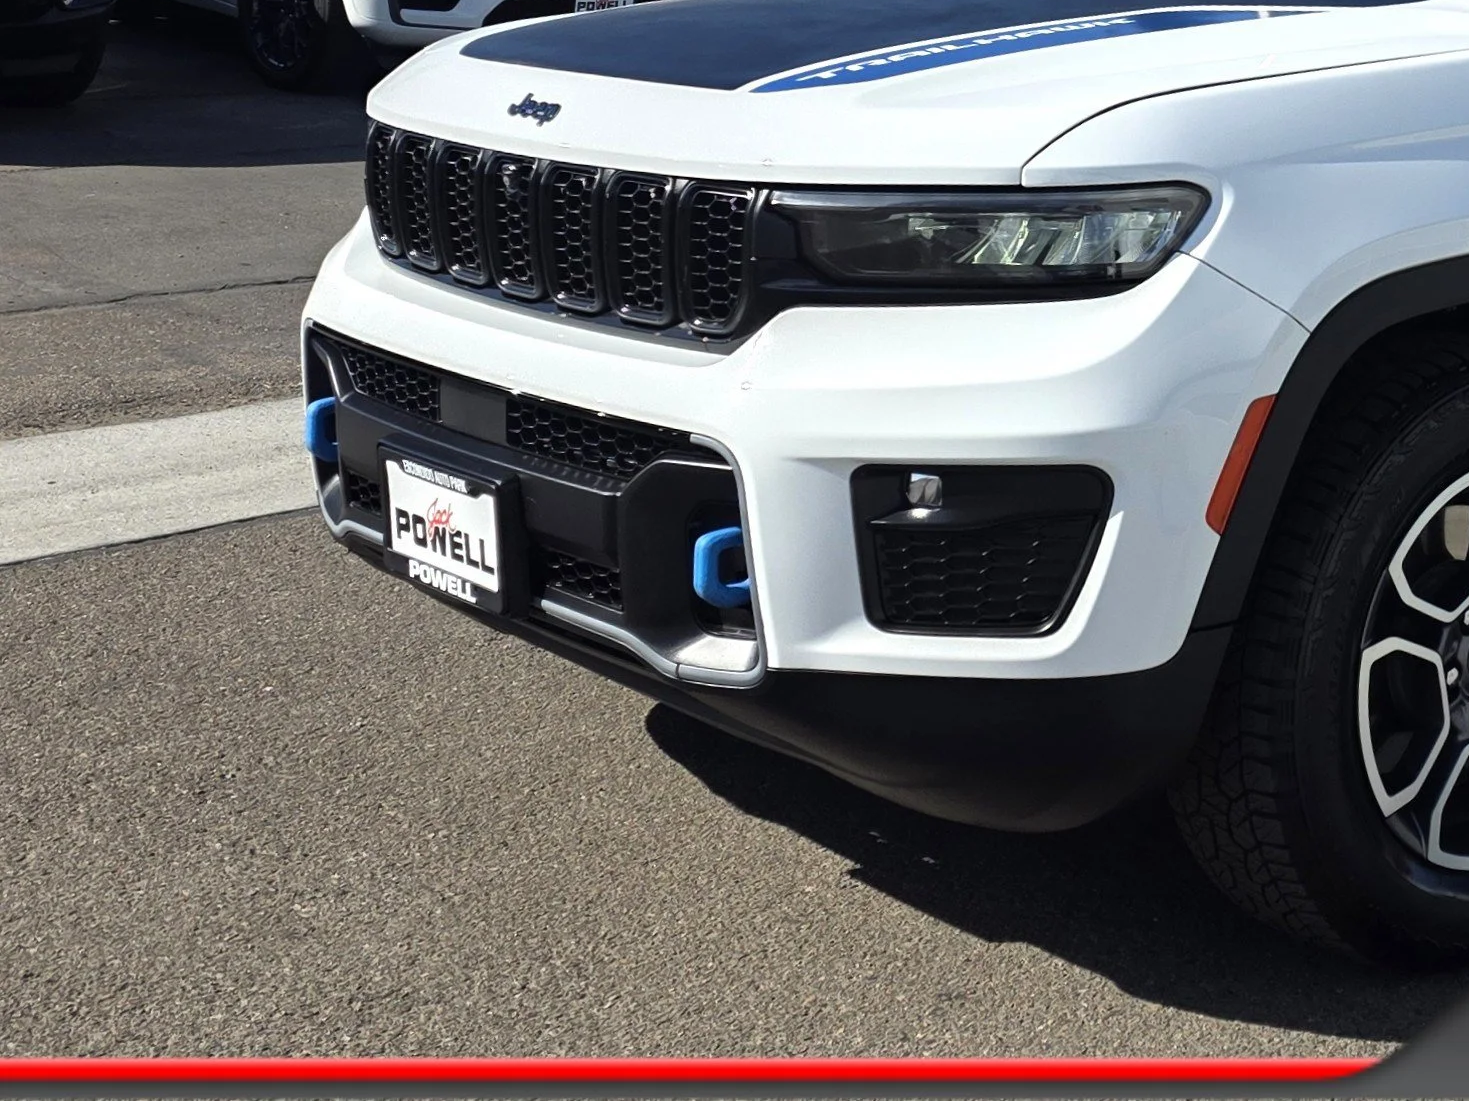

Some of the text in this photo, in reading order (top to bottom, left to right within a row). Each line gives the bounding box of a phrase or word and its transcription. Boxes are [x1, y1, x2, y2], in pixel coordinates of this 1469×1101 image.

[796, 17, 1137, 82] TRAILHAWK
[507, 92, 562, 127] Jeep
[427, 498, 457, 538] Jack
[395, 507, 495, 576] POWELL
[408, 559, 478, 604] POWELL
